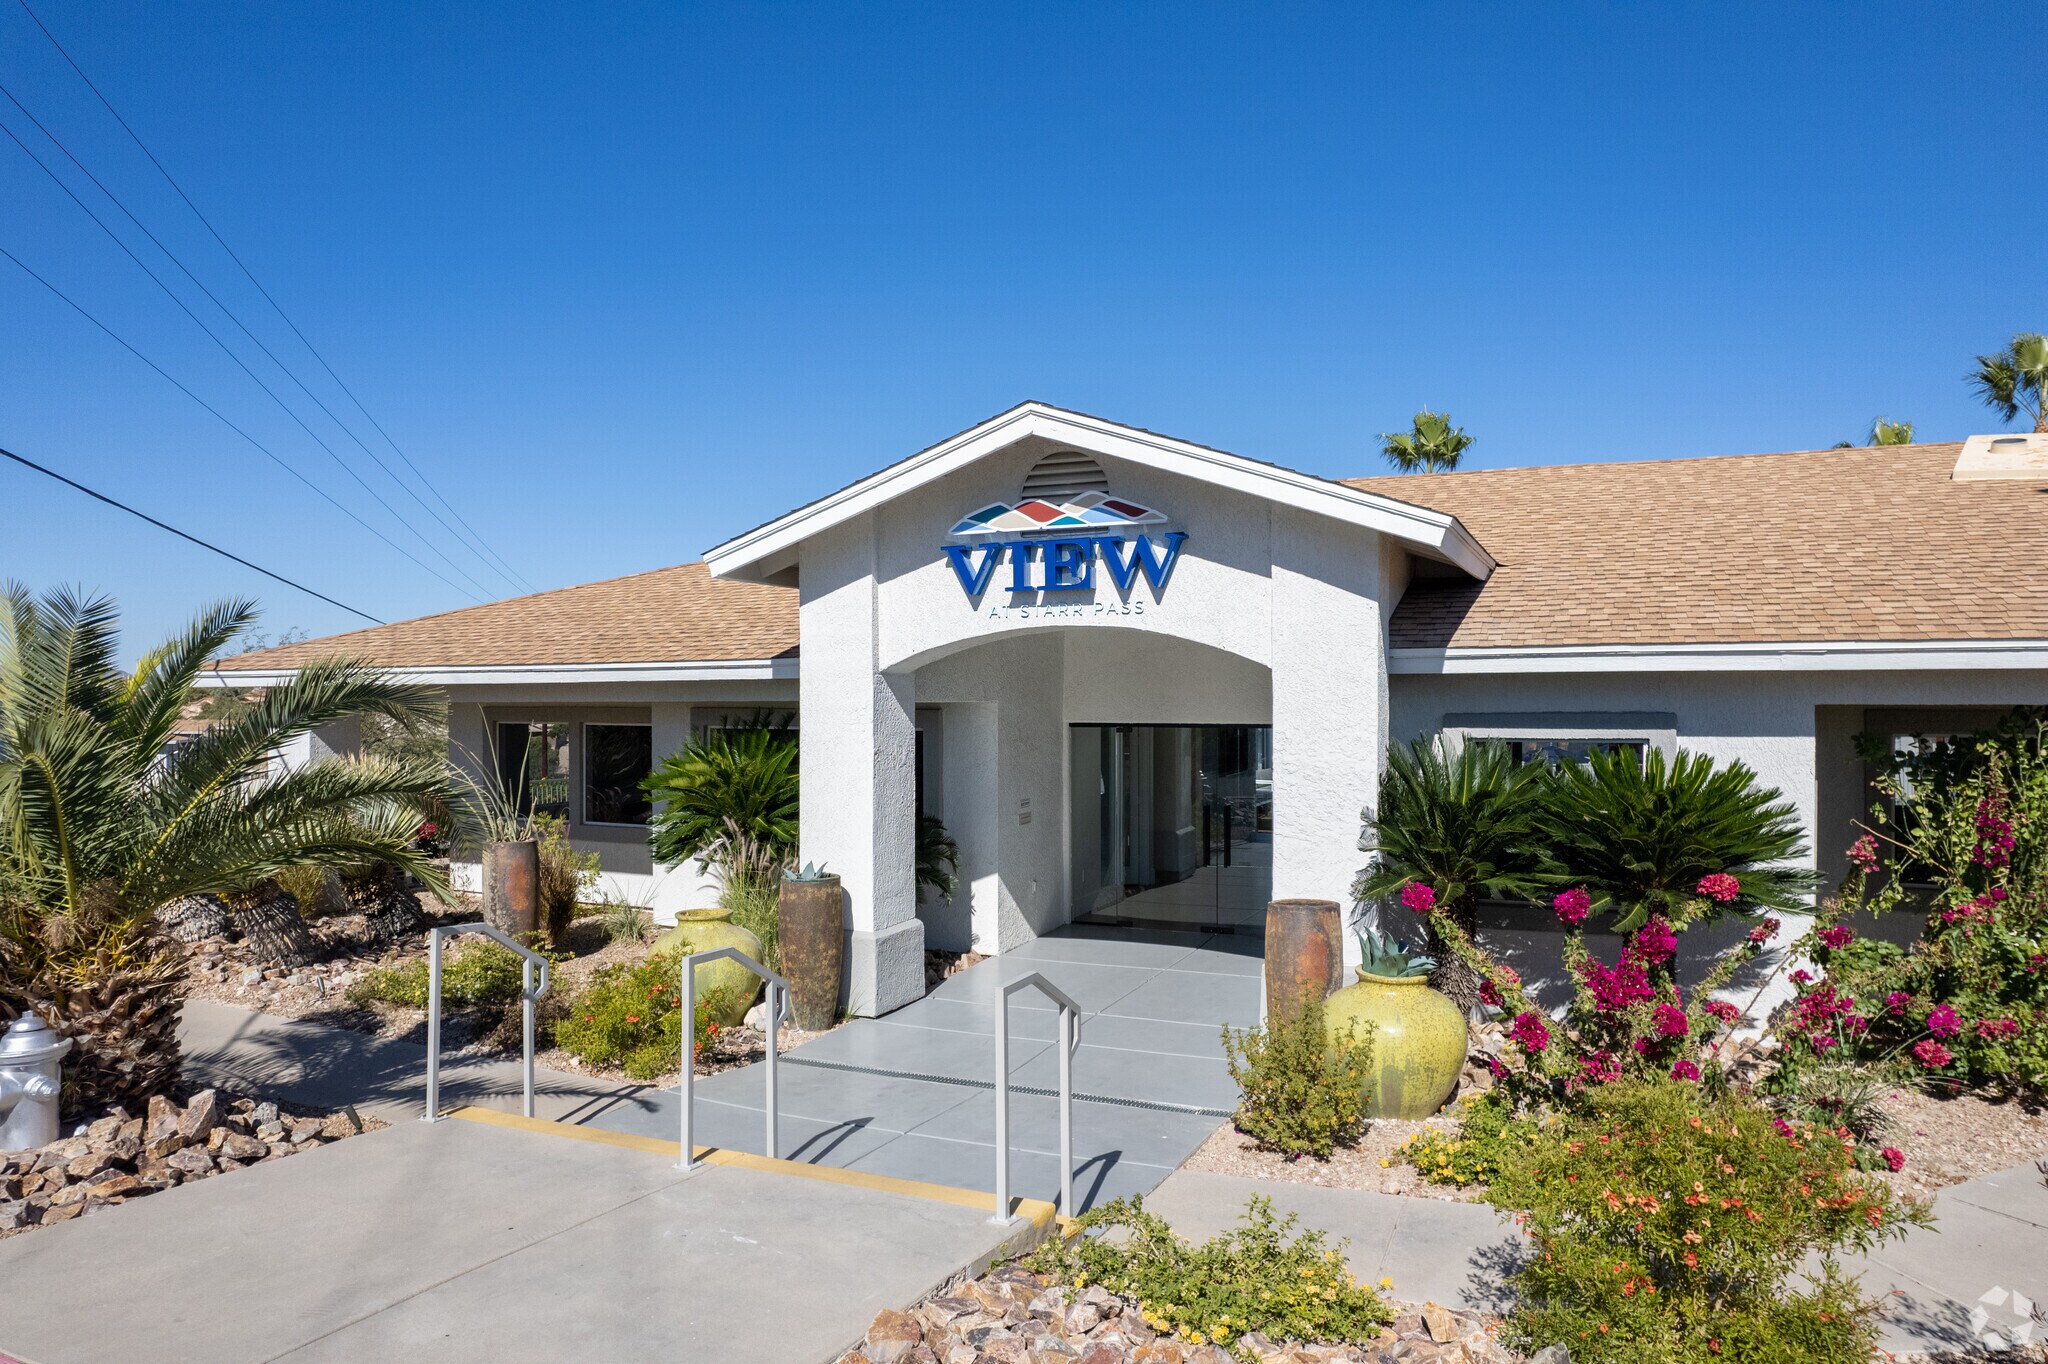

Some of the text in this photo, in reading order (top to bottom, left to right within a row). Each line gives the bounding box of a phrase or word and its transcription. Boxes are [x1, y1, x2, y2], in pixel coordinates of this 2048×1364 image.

[941, 531, 1189, 596] VIEW
[989, 600, 1145, 620] AT STARR PASS
